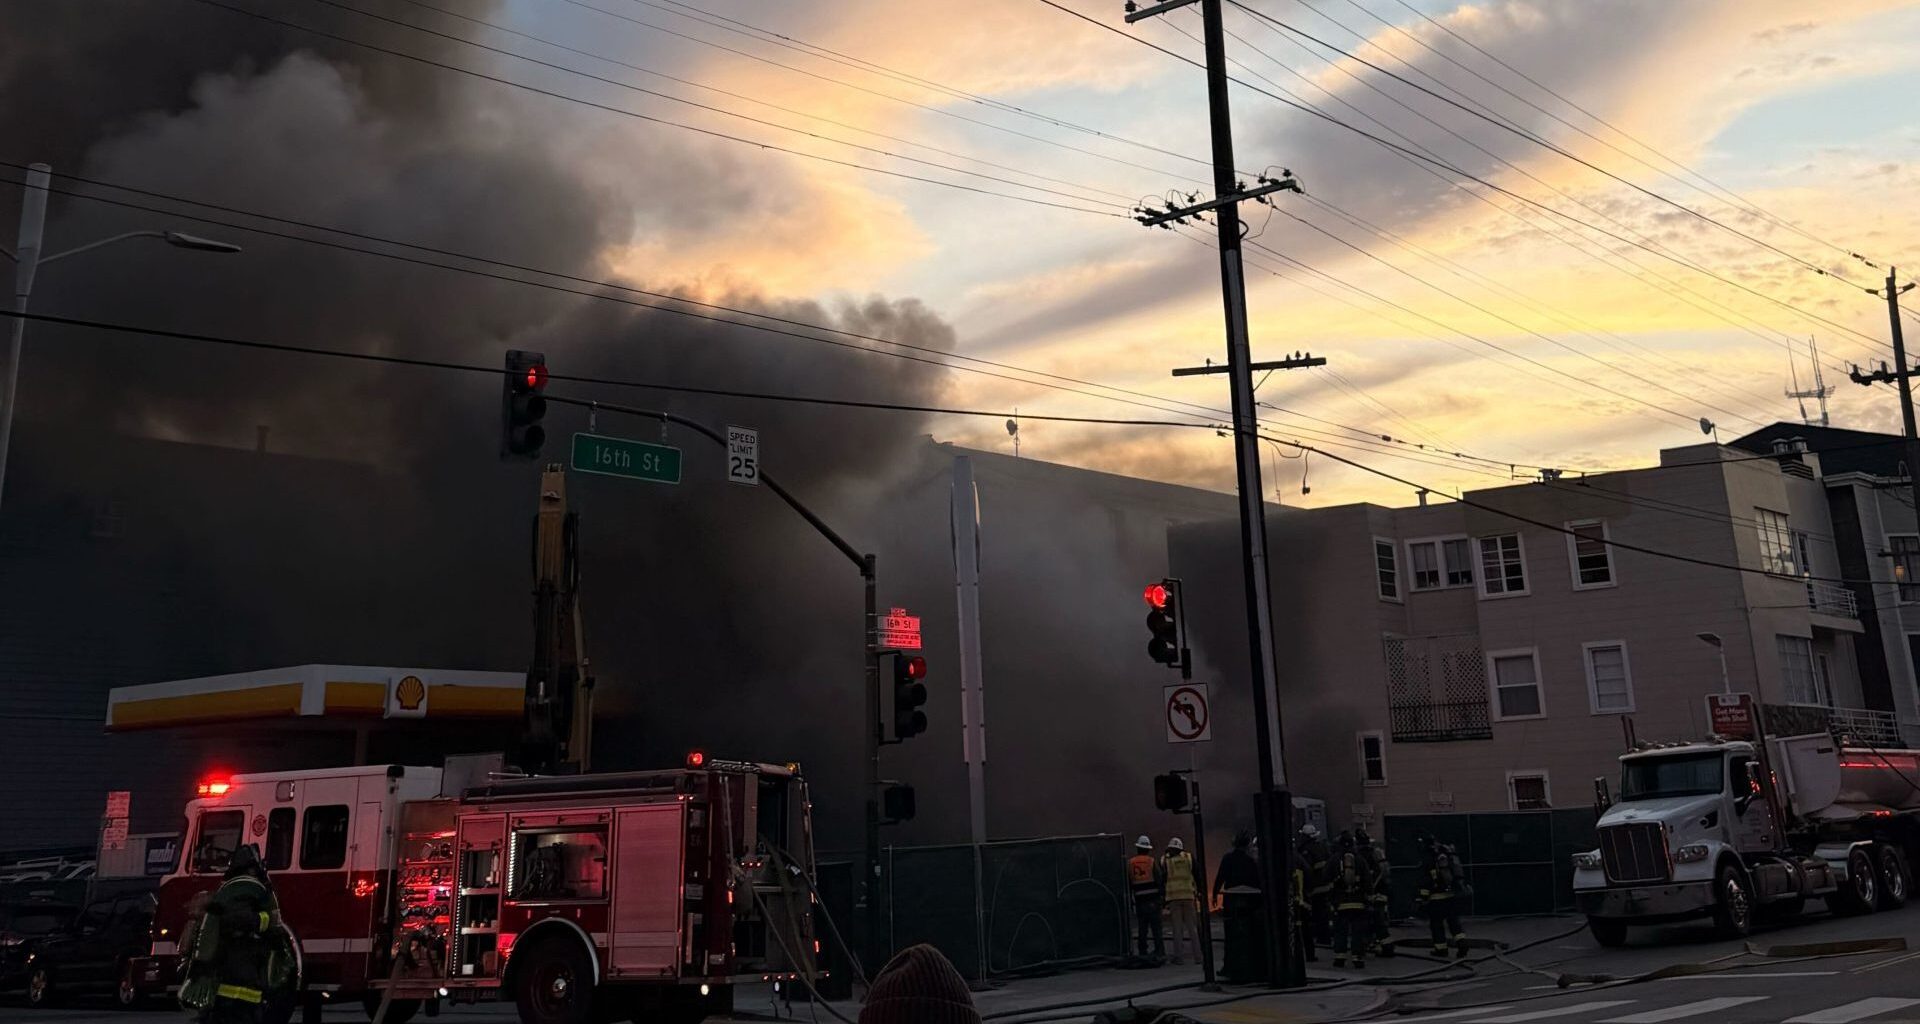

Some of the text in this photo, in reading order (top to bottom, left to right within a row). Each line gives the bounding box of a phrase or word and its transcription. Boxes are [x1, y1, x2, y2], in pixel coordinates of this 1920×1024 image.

[729, 432, 756, 445] SPEED
[732, 443, 753, 455] LIMIT
[595, 445, 661, 473] 16th St
[731, 456, 756, 479] 25
[887, 618, 900, 628] 16th
